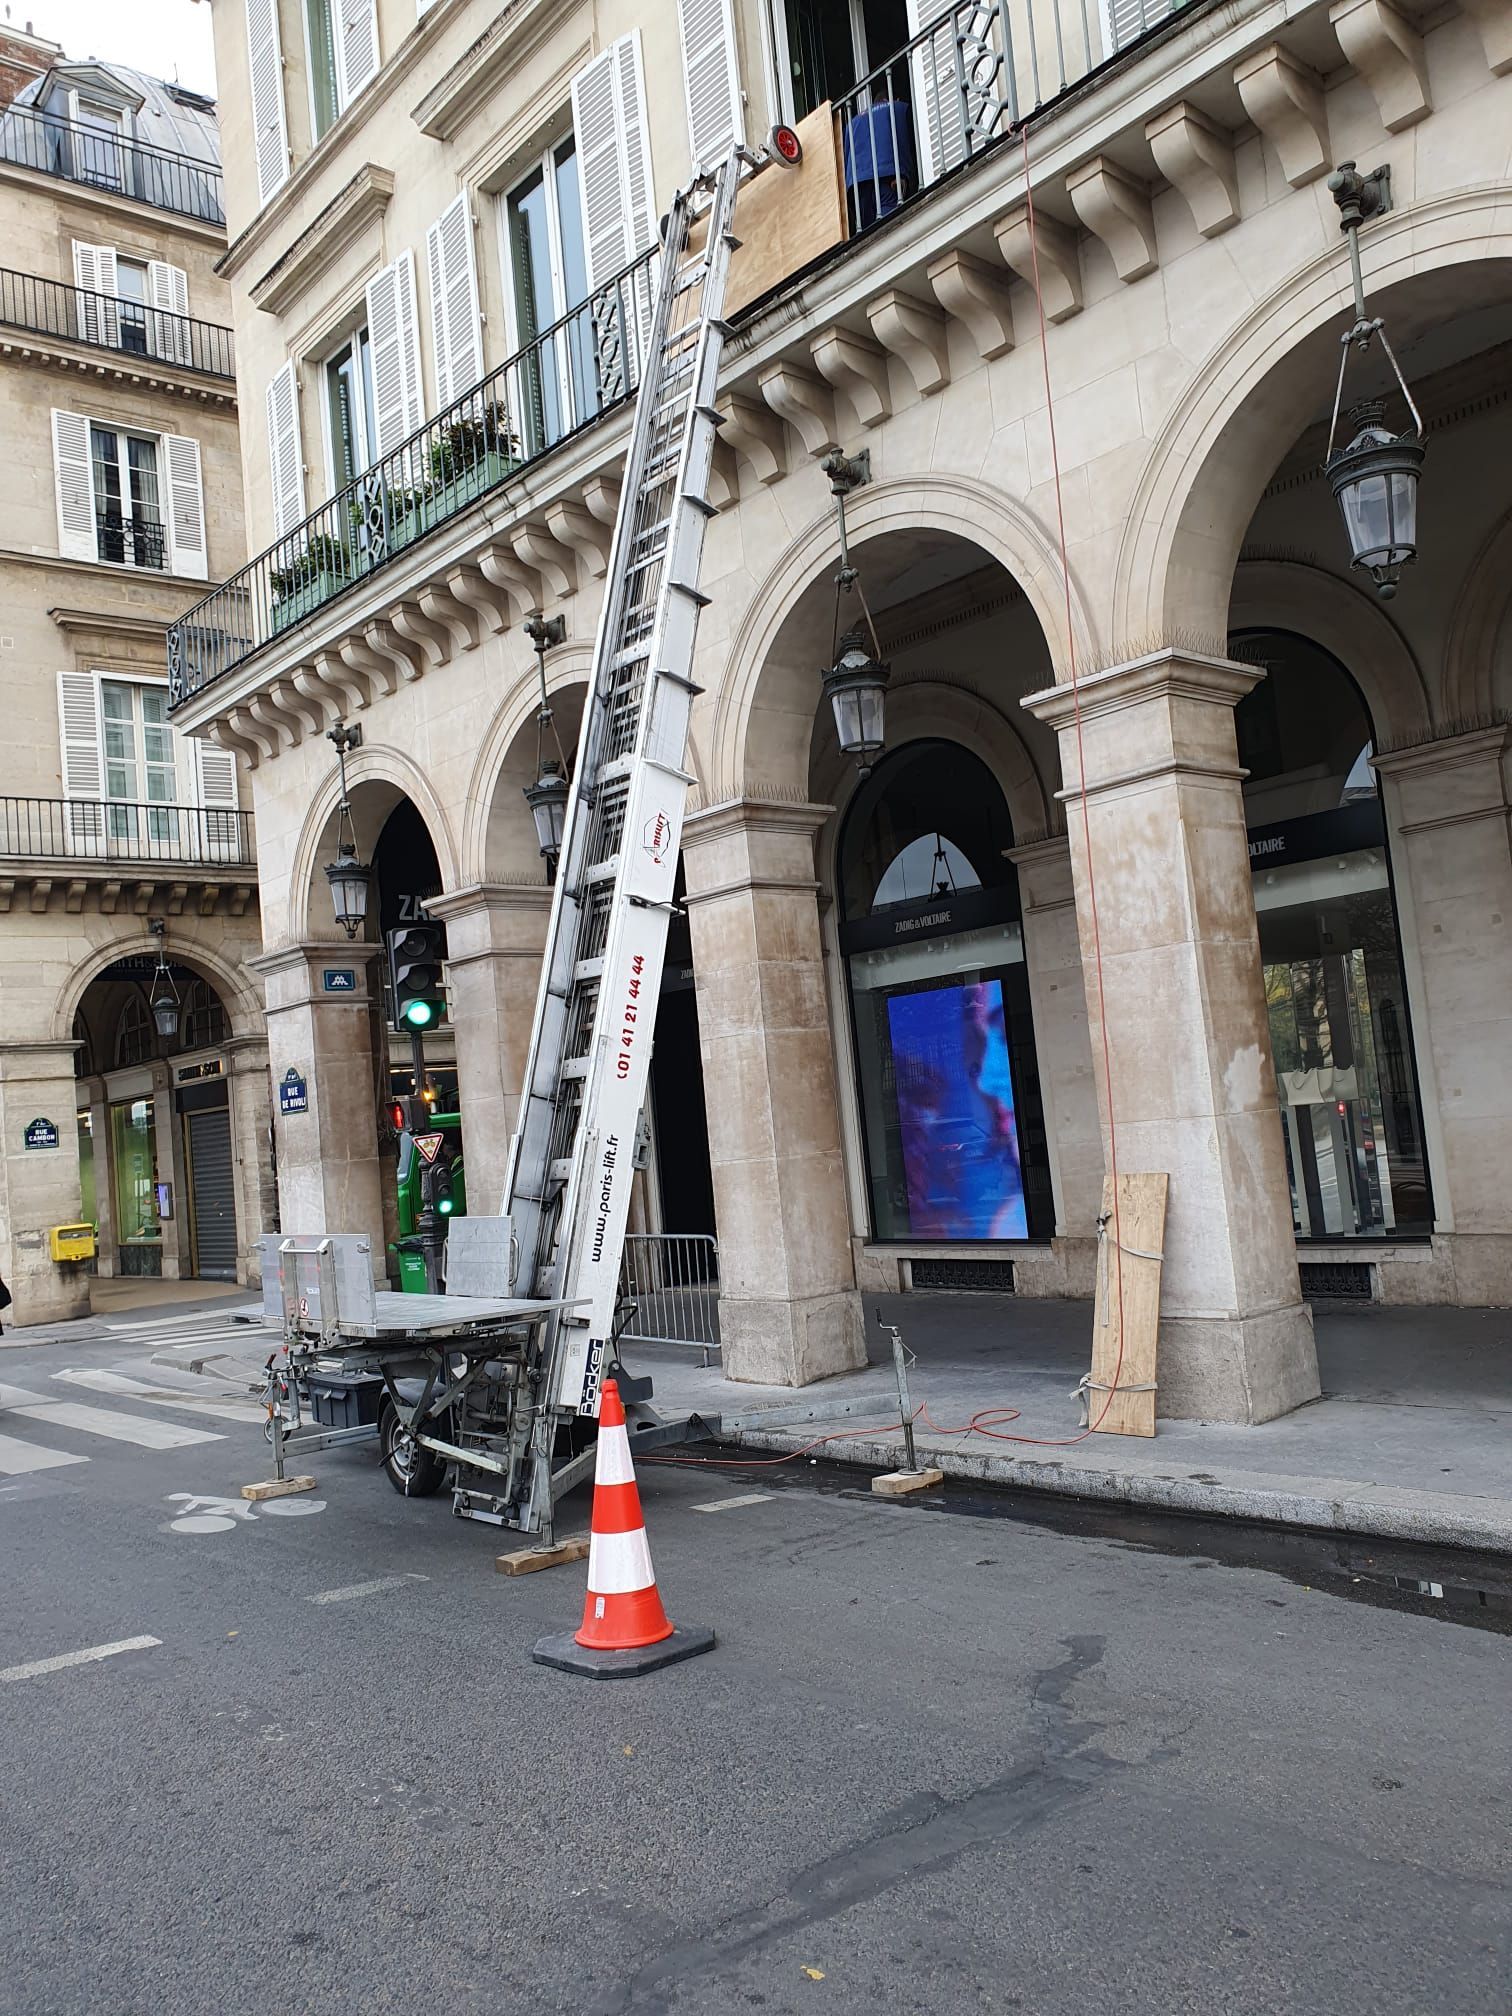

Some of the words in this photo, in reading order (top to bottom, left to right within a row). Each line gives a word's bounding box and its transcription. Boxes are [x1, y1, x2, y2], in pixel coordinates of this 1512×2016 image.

[631, 954, 645, 976] 44
[628, 978, 642, 999] 44
[624, 1003, 638, 1024] 21
[621, 1027, 635, 1048] 41
[617, 1052, 631, 1072] 01
[287, 1086, 299, 1097] RUE
[282, 1099, 289, 1109] DE
[28, 1134, 55, 1142] CAMBON
[591, 1133, 619, 1263] www.paris-lift.fr
[580, 1339, 603, 1417] Böcker
